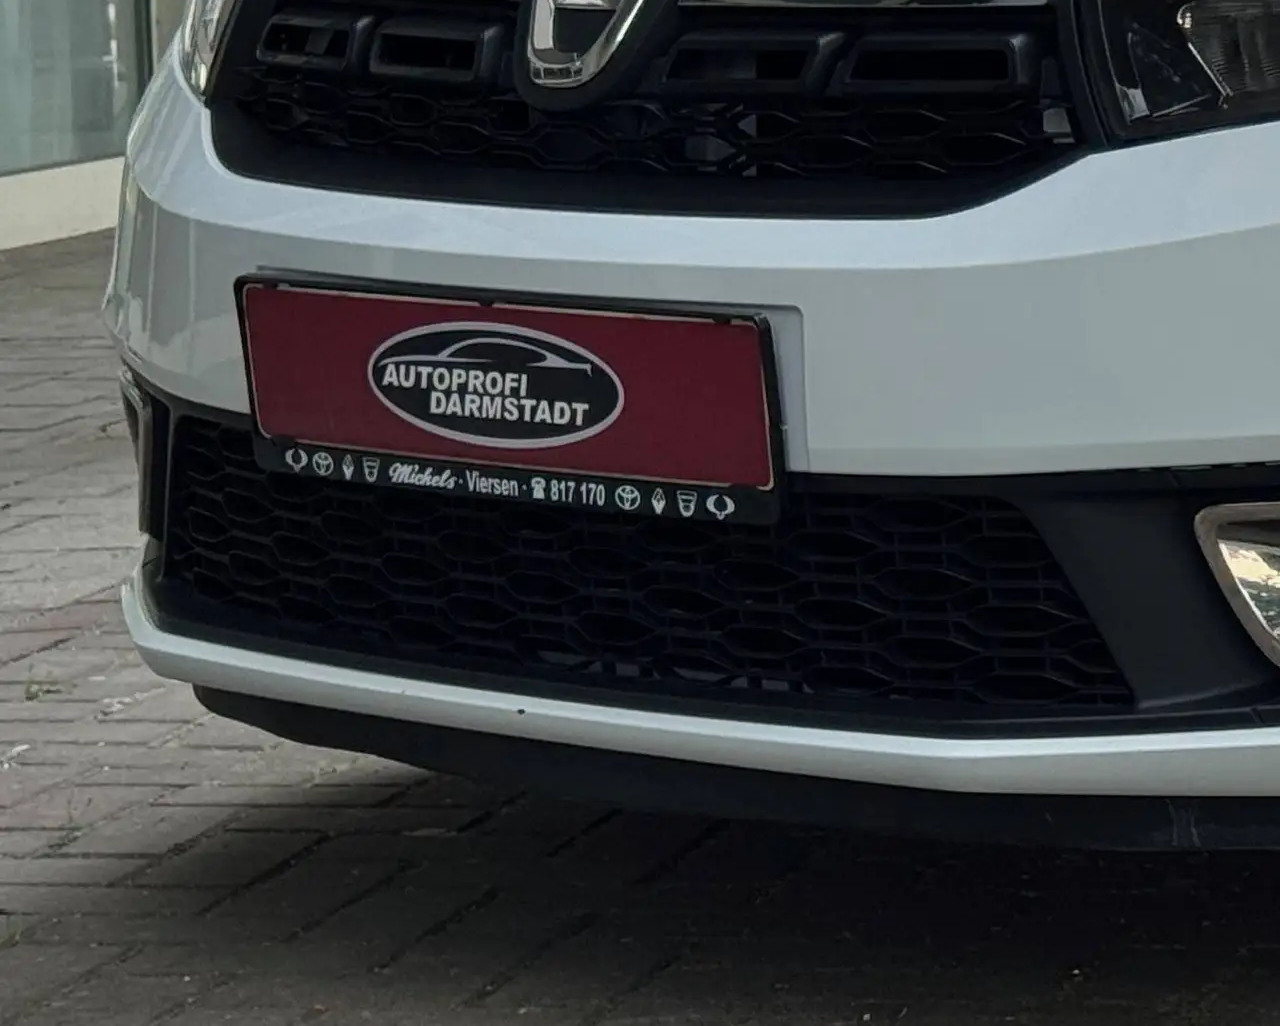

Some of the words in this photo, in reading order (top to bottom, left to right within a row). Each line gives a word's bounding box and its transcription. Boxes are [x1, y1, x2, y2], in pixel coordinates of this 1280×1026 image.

[382, 363, 528, 397] AUTOPROFI
[429, 391, 589, 426] DARMSTADT
[388, 462, 457, 489] Michels
[465, 469, 519, 496] Viersen
[550, 479, 576, 503] 817
[579, 481, 606, 507] 170
